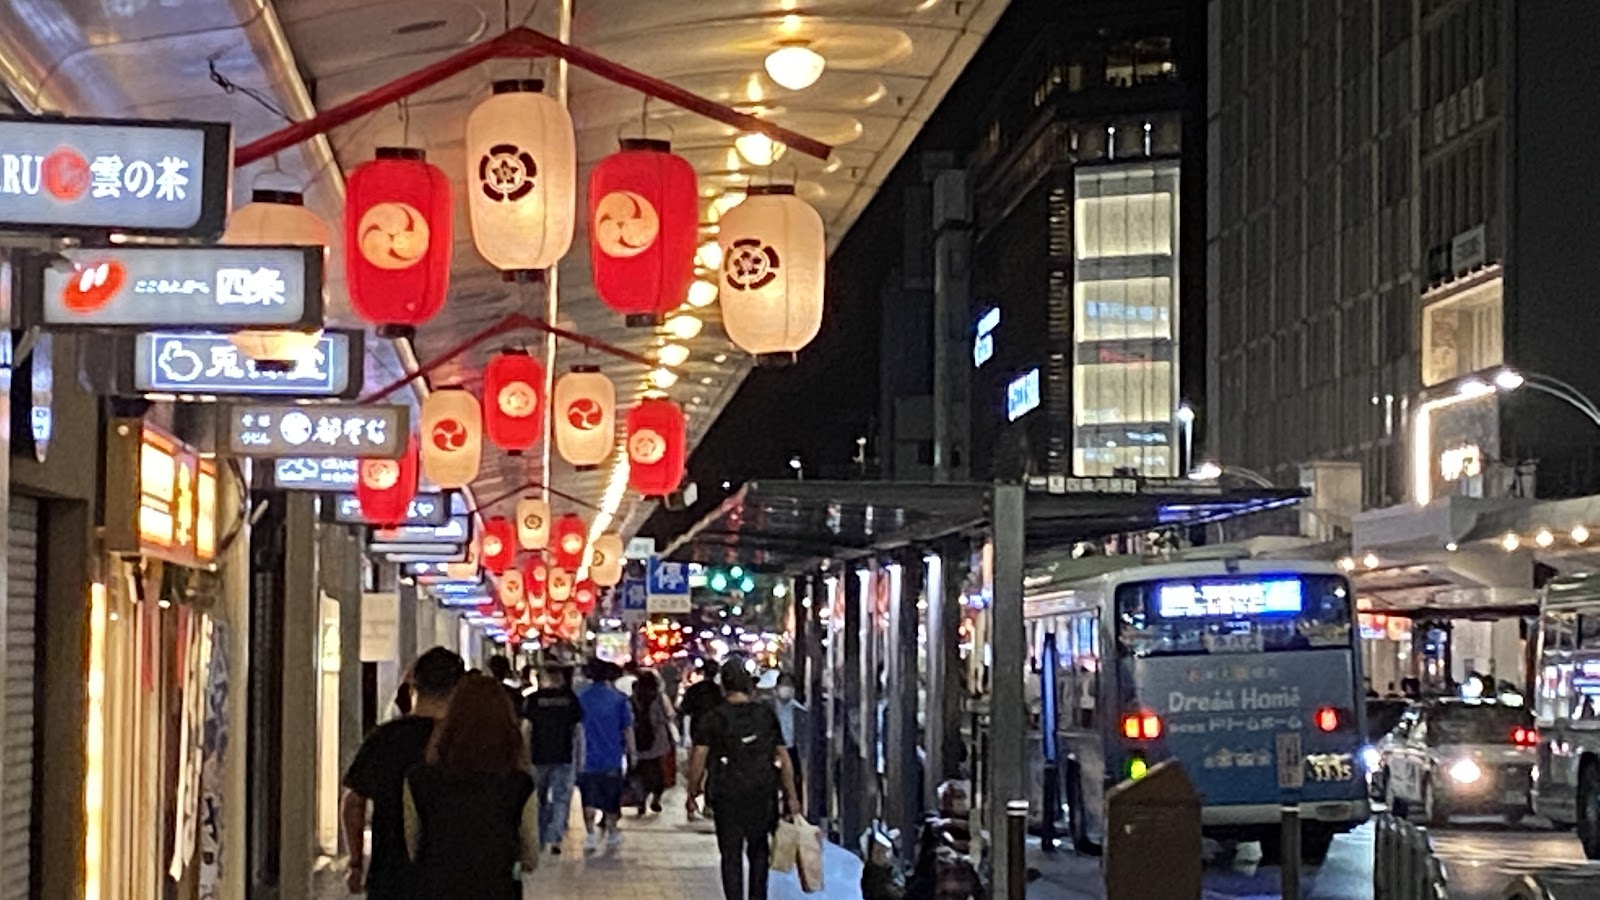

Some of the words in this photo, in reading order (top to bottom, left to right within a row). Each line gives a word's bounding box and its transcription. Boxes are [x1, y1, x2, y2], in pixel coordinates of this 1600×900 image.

[0, 153, 44, 195] RU
[90, 154, 189, 201] 雲の茶
[654, 561, 685, 590] 停
